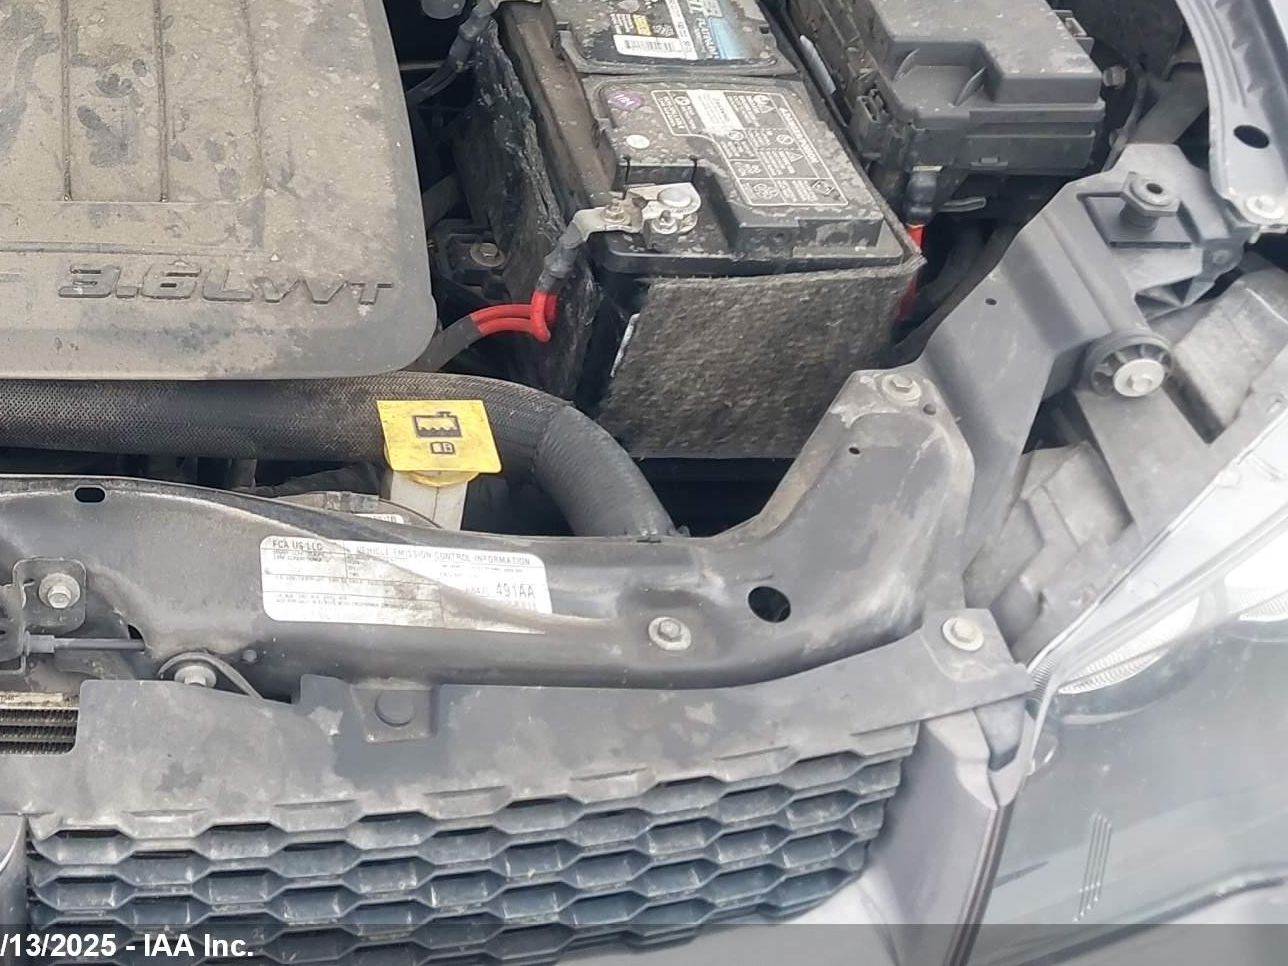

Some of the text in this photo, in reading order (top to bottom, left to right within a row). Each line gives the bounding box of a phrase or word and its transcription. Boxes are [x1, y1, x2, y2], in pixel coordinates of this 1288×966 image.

[272, 540, 322, 551] FCA US LLC
[393, 548, 432, 559] EMISSION
[434, 551, 471, 562] CONTROL
[474, 554, 531, 566] INFORMATION
